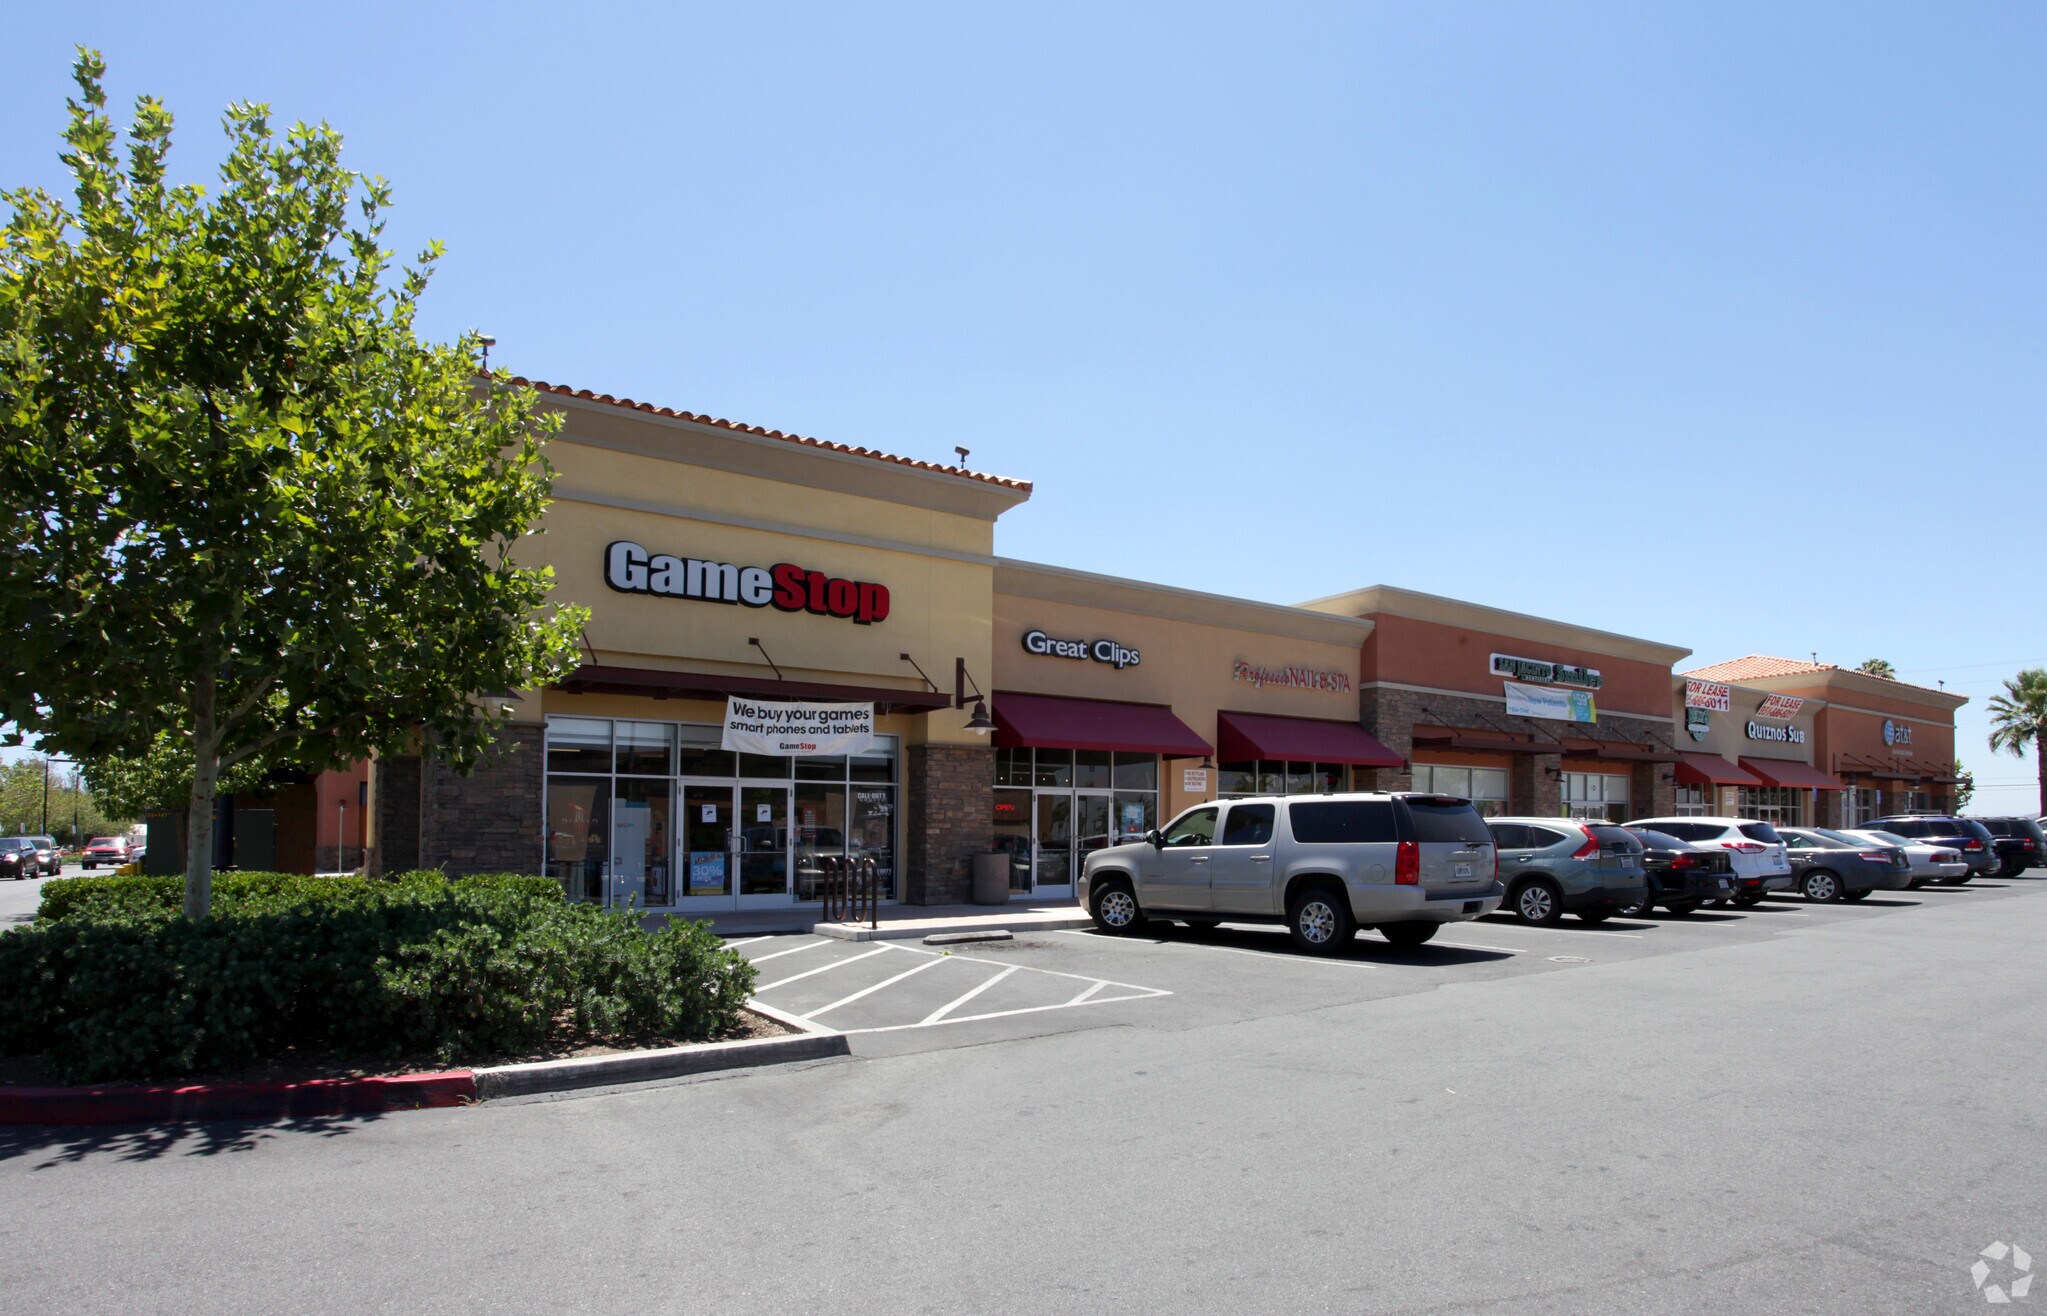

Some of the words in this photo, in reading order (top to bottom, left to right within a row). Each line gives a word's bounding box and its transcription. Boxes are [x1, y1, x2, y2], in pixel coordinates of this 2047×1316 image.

[606, 540, 890, 625] GameStop
[1026, 630, 1089, 659] Great
[1092, 640, 1140, 668] Clips
[1233, 660, 1320, 689] ProfessioNAIL
[1330, 671, 1351, 692] SPA
[1553, 664, 1604, 688] Smiles
[1702, 684, 1729, 698] LEASE
[1765, 695, 1782, 707] FOR
[1780, 698, 1803, 710] LEASE
[733, 702, 756, 718] We
[757, 706, 783, 723] buy
[785, 709, 817, 723] your
[818, 709, 869, 724] games
[730, 721, 764, 734] smart
[766, 724, 807, 736] phones
[808, 725, 831, 735] and
[833, 723, 870, 735] tablets
[1895, 724, 1912, 745] at&t
[779, 742, 817, 751] GameStop
[995, 803, 1015, 811] OPEN
[692, 865, 723, 877] 30%
